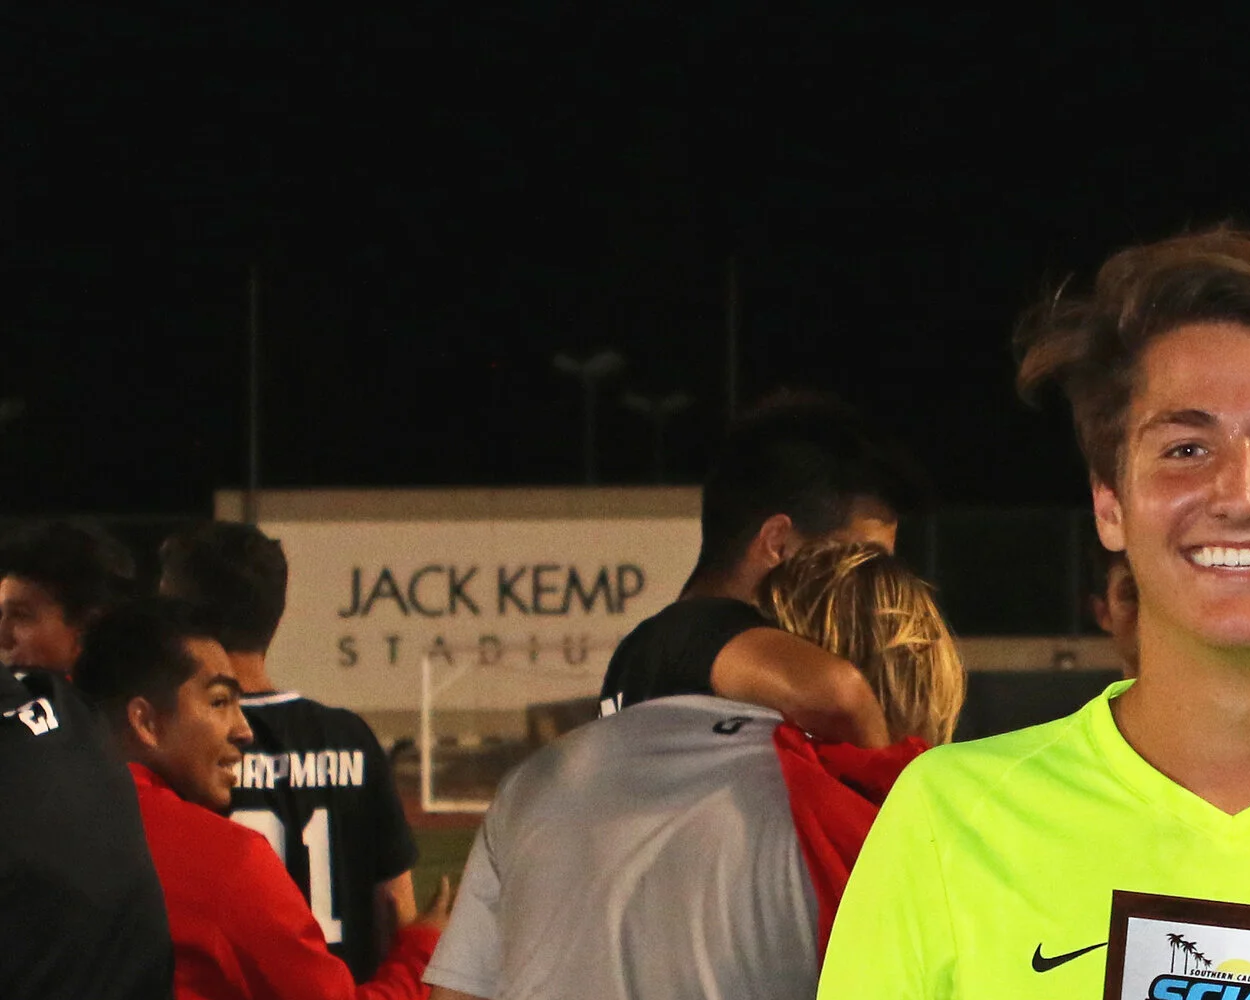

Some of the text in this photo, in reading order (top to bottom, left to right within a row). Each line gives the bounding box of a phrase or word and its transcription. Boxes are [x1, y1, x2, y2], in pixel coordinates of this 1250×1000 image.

[337, 563, 646, 619] JACK KEMP
[337, 633, 590, 668] STADIU
[231, 750, 364, 790] APMAN
[1189, 968, 1235, 981] SOUTHERN
